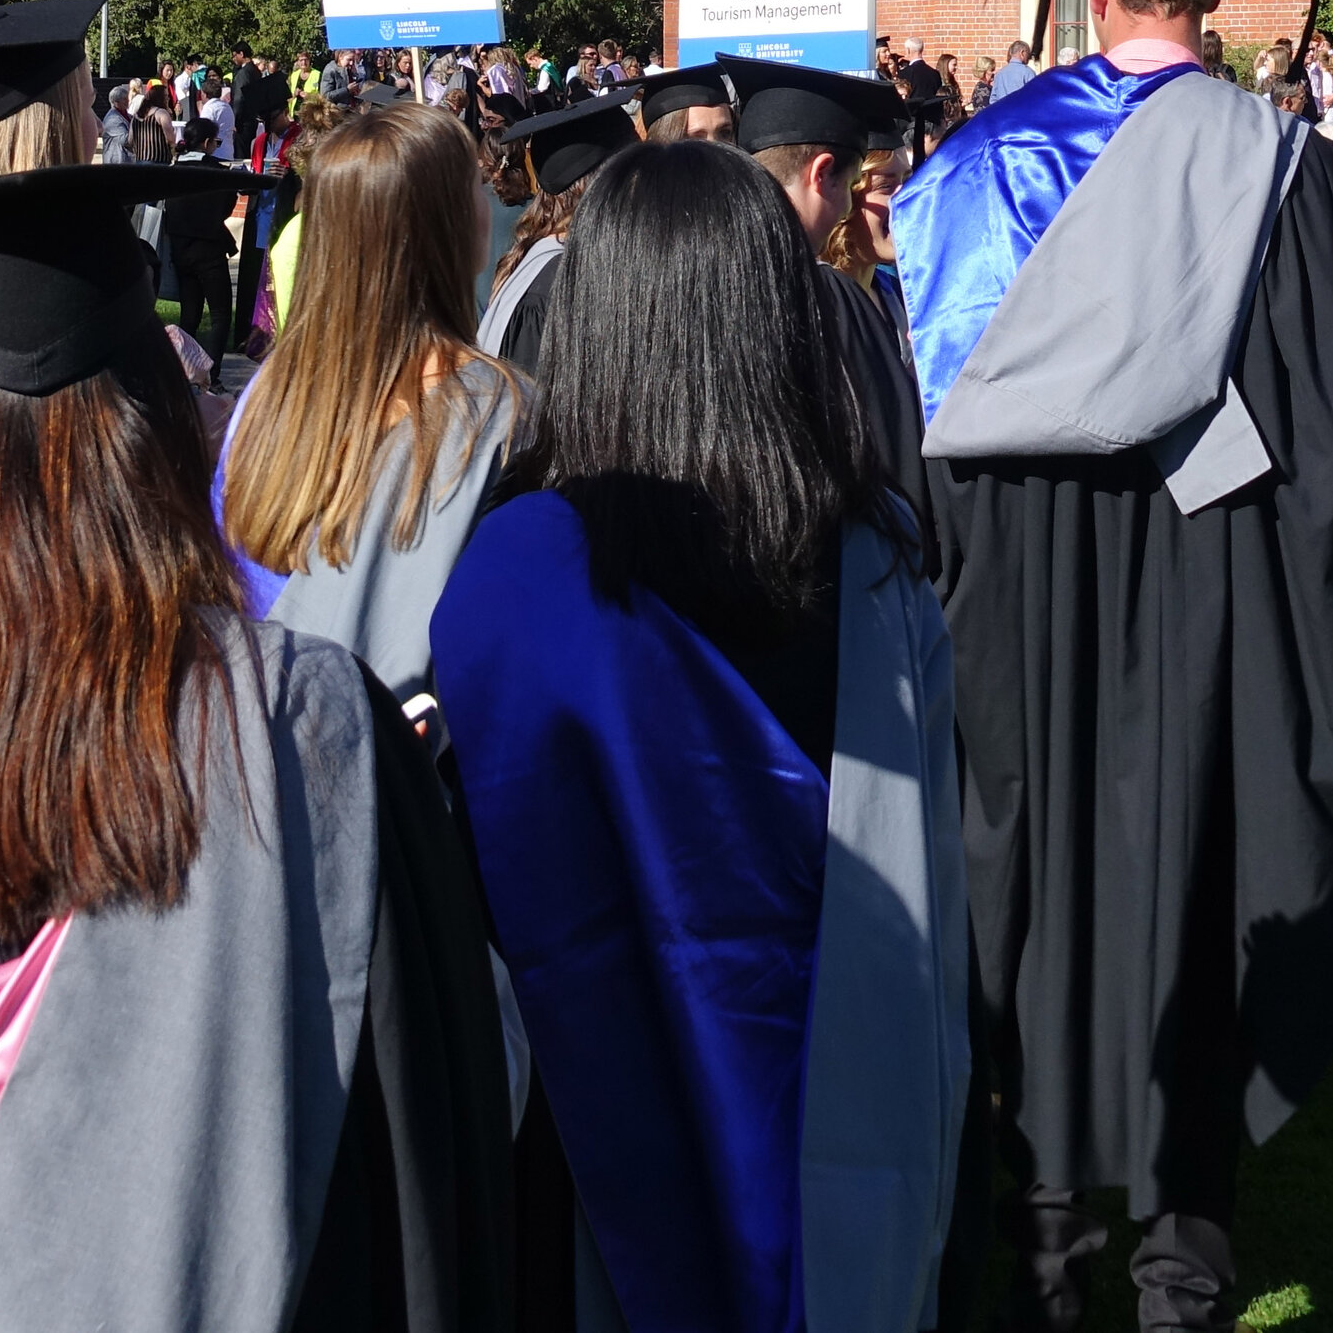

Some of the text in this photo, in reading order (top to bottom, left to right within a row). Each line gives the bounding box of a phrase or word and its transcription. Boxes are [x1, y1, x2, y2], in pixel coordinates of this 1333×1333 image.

[702, 2, 842, 21] Tourism Management
[396, 20, 427, 28] LINCOLN
[397, 26, 440, 34] UNIVERSITY
[756, 43, 790, 51] LINCOLN
[756, 49, 804, 58] UNIVERSITY
